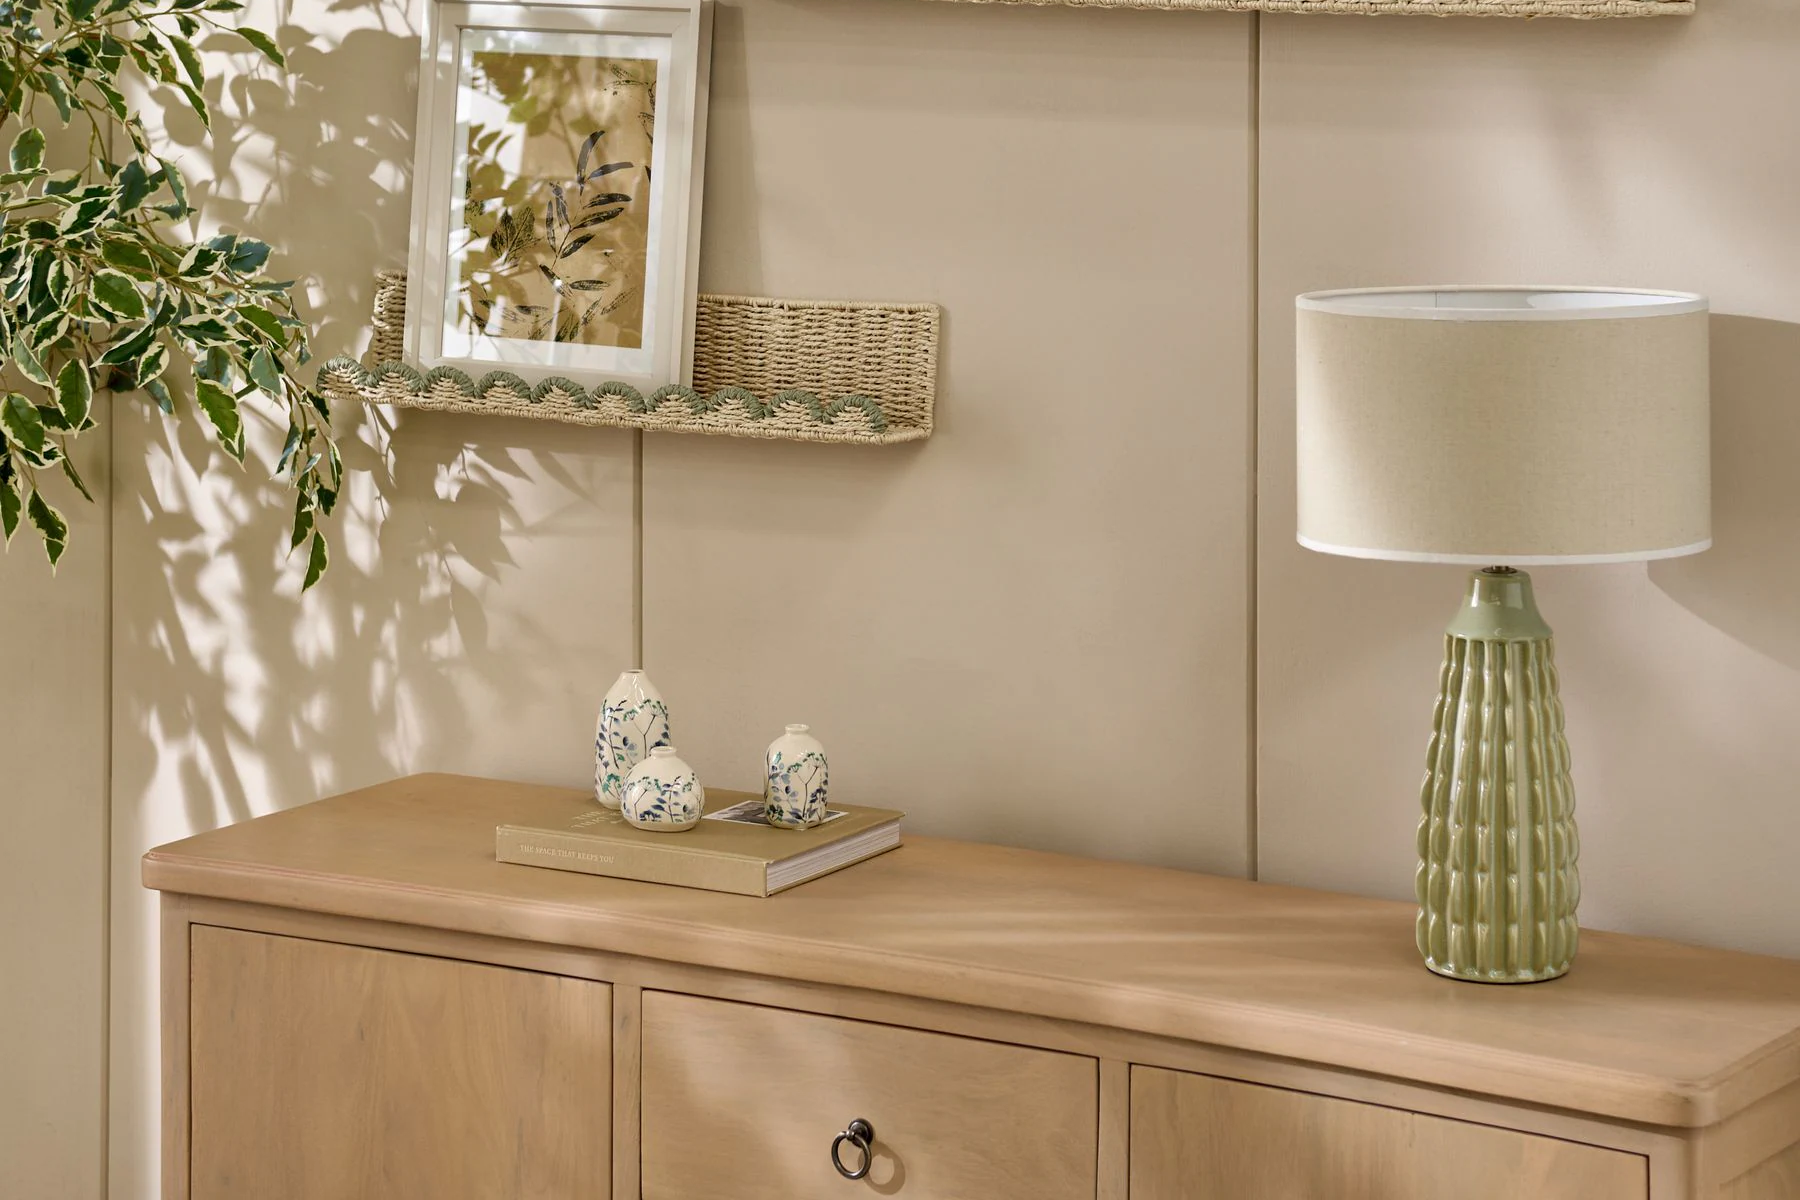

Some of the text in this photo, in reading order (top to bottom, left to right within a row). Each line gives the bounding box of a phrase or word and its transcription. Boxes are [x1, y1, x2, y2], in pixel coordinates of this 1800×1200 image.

[520, 844, 534, 853] THE
[535, 847, 556, 856] SPACE
[557, 849, 576, 858] THAT
[599, 855, 615, 864] YOU
